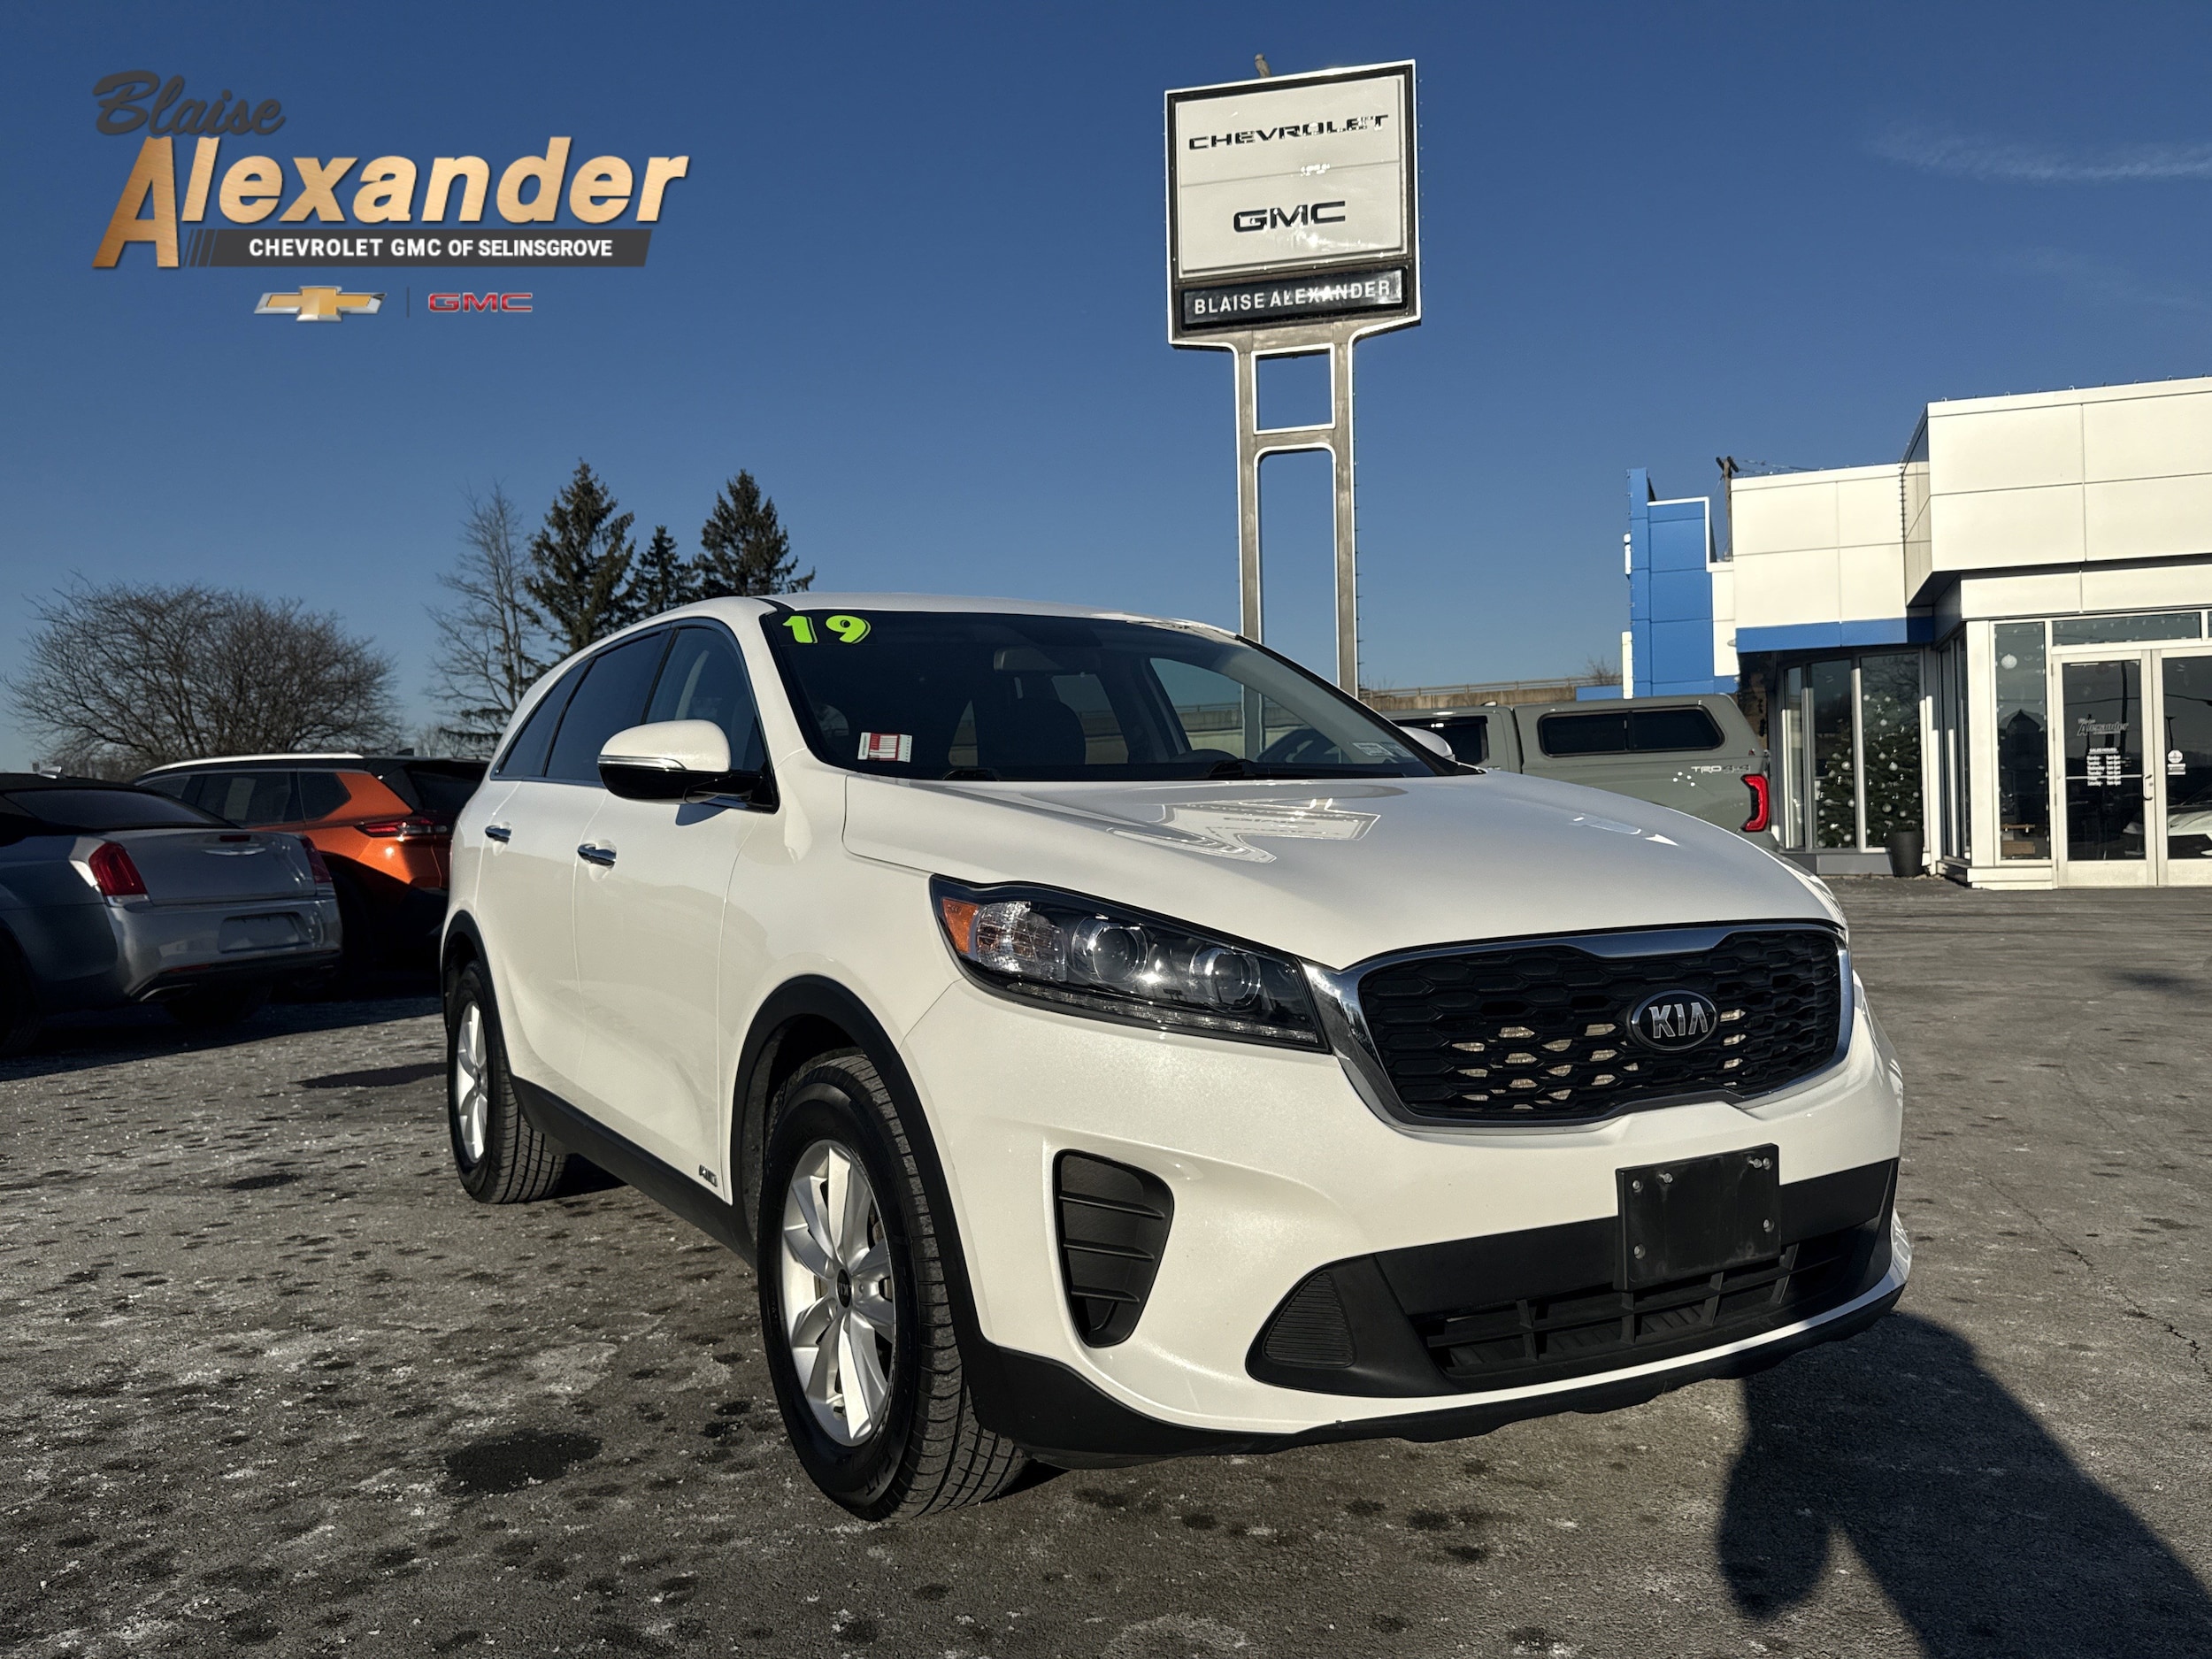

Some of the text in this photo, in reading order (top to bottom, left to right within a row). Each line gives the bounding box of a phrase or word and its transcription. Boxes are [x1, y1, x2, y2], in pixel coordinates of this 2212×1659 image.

[1189, 114, 1388, 150] CHEVROLET
[1233, 201, 1346, 233] GMC
[1194, 280, 1390, 315] BLAISE ALEXANDER
[782, 615, 872, 644] 19
[1691, 765, 1722, 774] TRD
[1648, 1002, 1709, 1039] KIA
